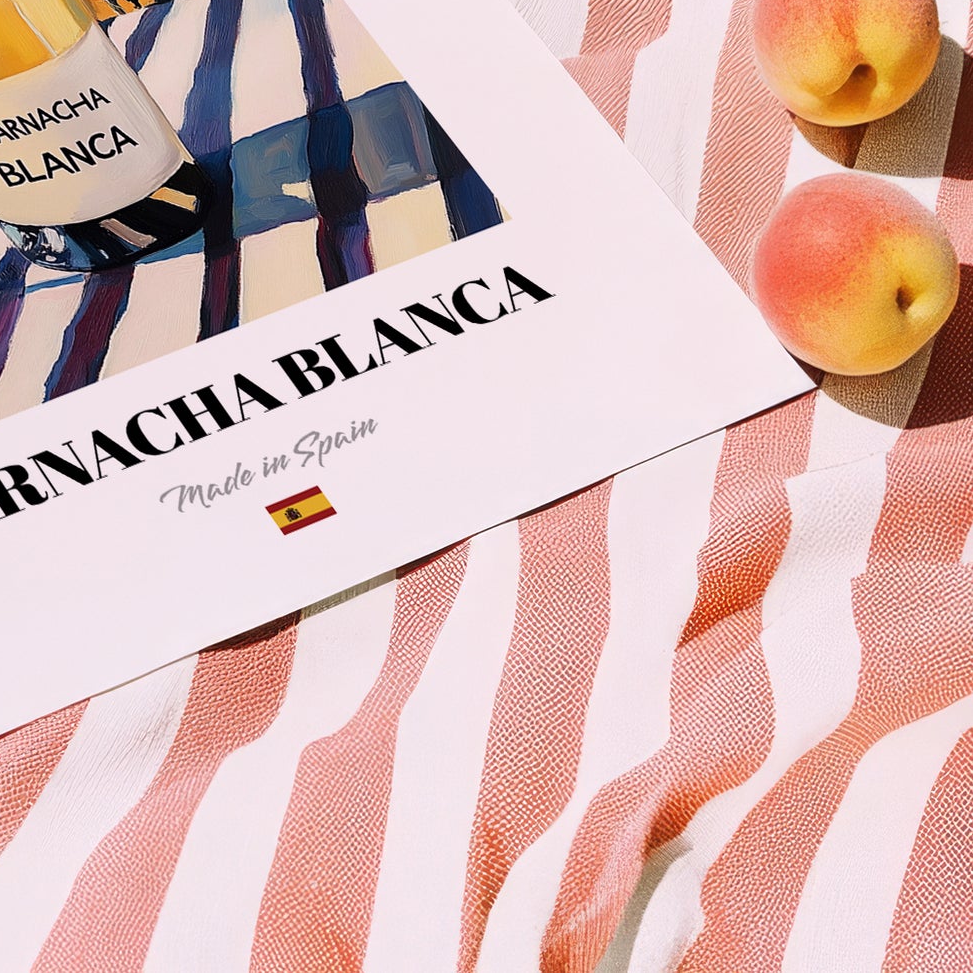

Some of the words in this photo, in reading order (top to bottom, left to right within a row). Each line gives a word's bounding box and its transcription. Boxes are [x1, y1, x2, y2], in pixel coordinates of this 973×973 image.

[271, 265, 555, 400] BLANCA
[159, 462, 256, 513] Made
[262, 454, 291, 478] in
[293, 418, 378, 467] Spain
